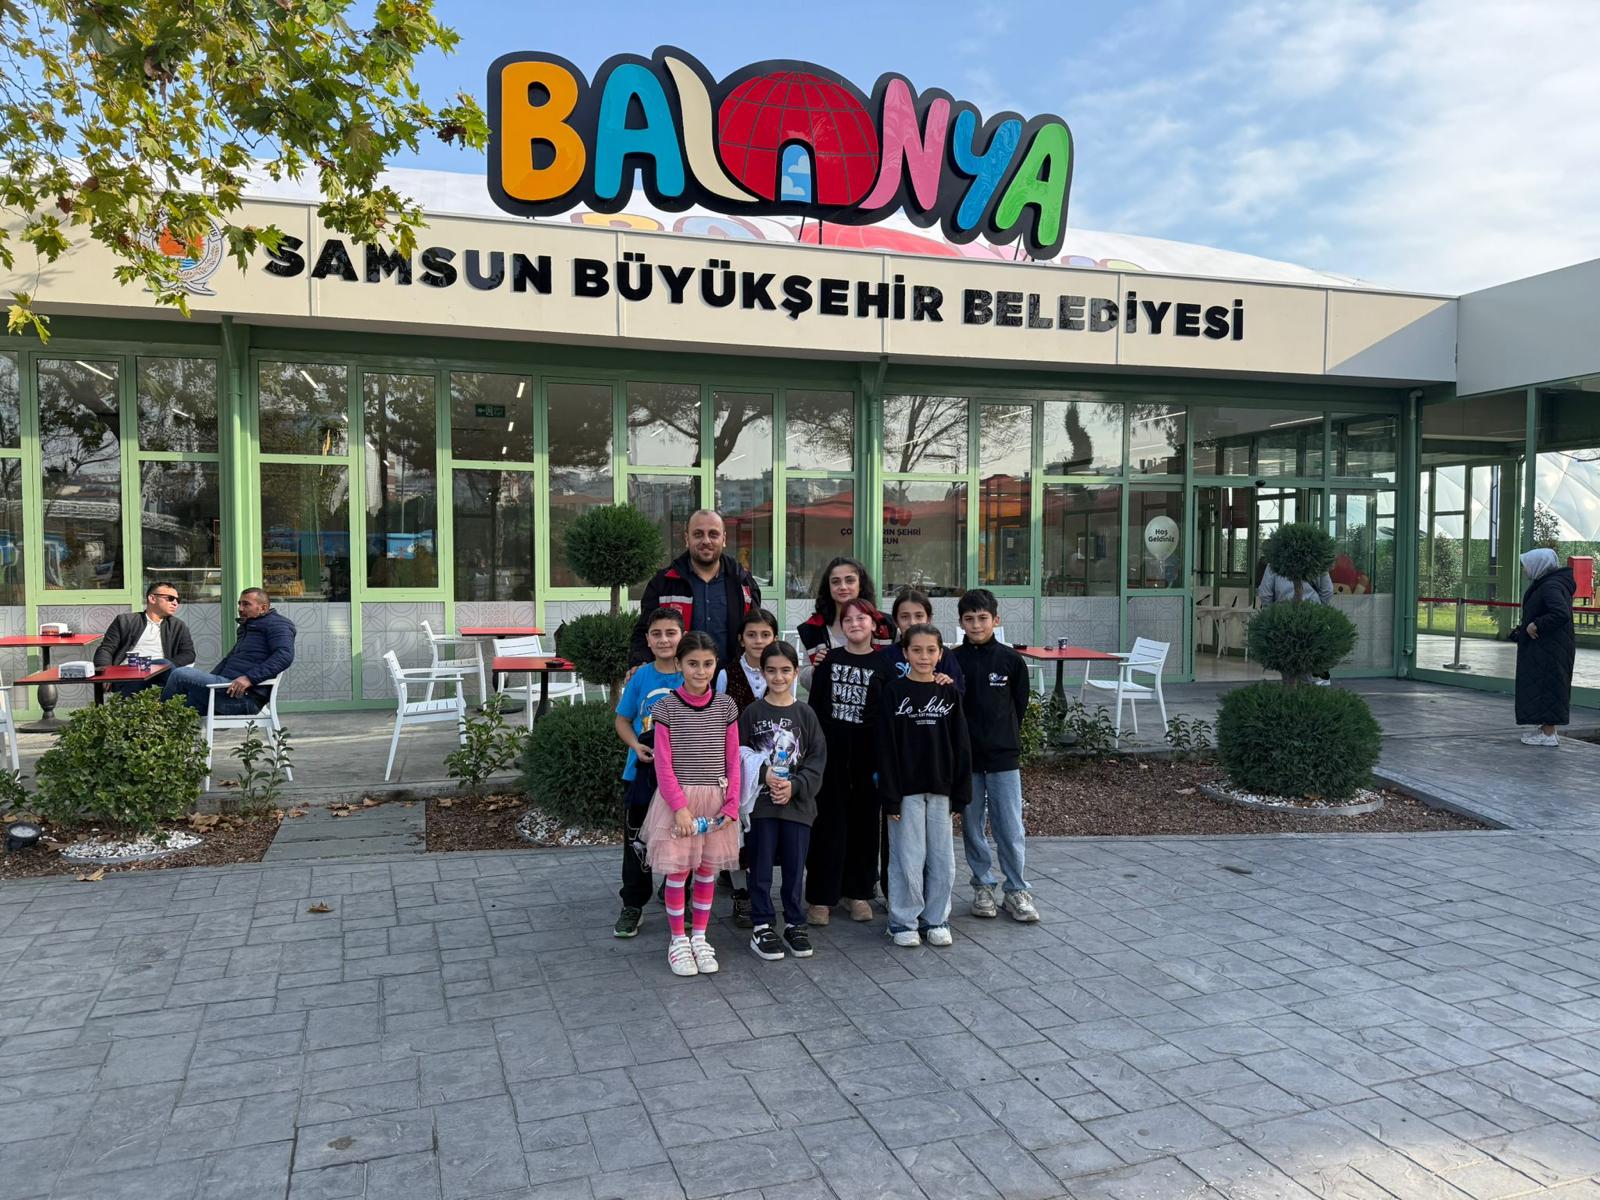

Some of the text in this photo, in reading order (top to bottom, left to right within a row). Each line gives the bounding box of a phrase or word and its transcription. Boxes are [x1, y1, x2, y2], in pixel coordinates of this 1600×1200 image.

[263, 234, 1244, 341] SAMSUN BÜYÜKŞEHİR BELEDİYESİ
[831, 663, 875, 686] STAY
[895, 697, 913, 716] Le
